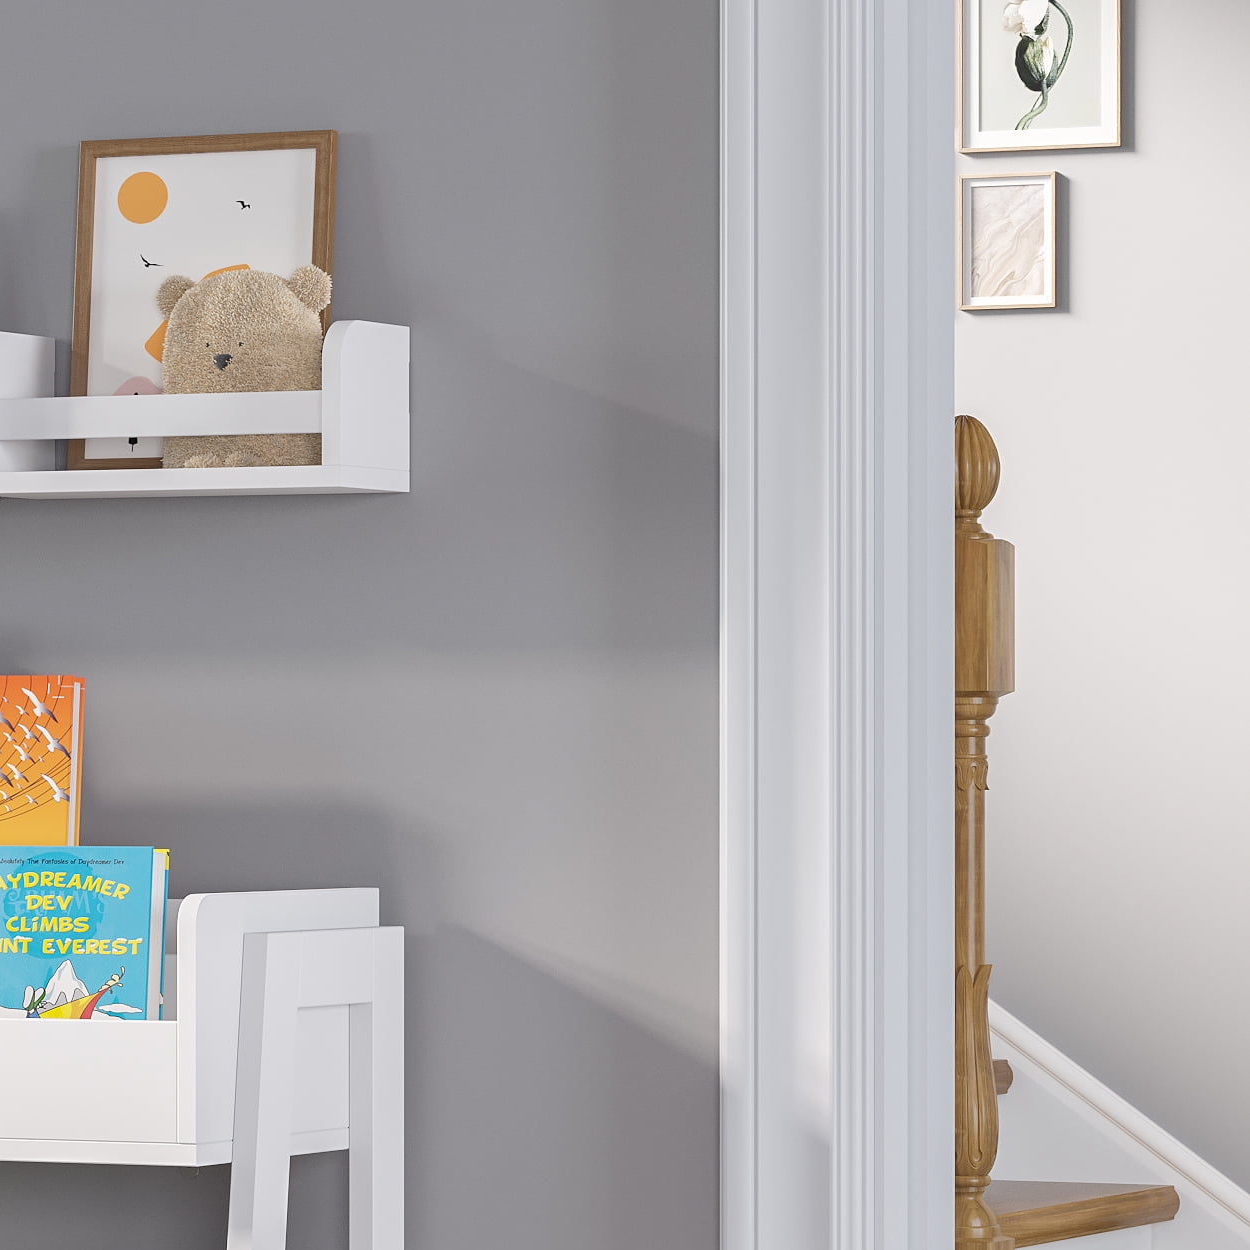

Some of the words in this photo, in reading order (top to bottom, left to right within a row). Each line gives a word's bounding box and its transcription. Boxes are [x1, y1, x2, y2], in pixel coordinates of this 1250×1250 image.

[78, 858, 112, 867] Daydreamer
[25, 895, 73, 911] DEV
[42, 937, 143, 955] EVEREST
